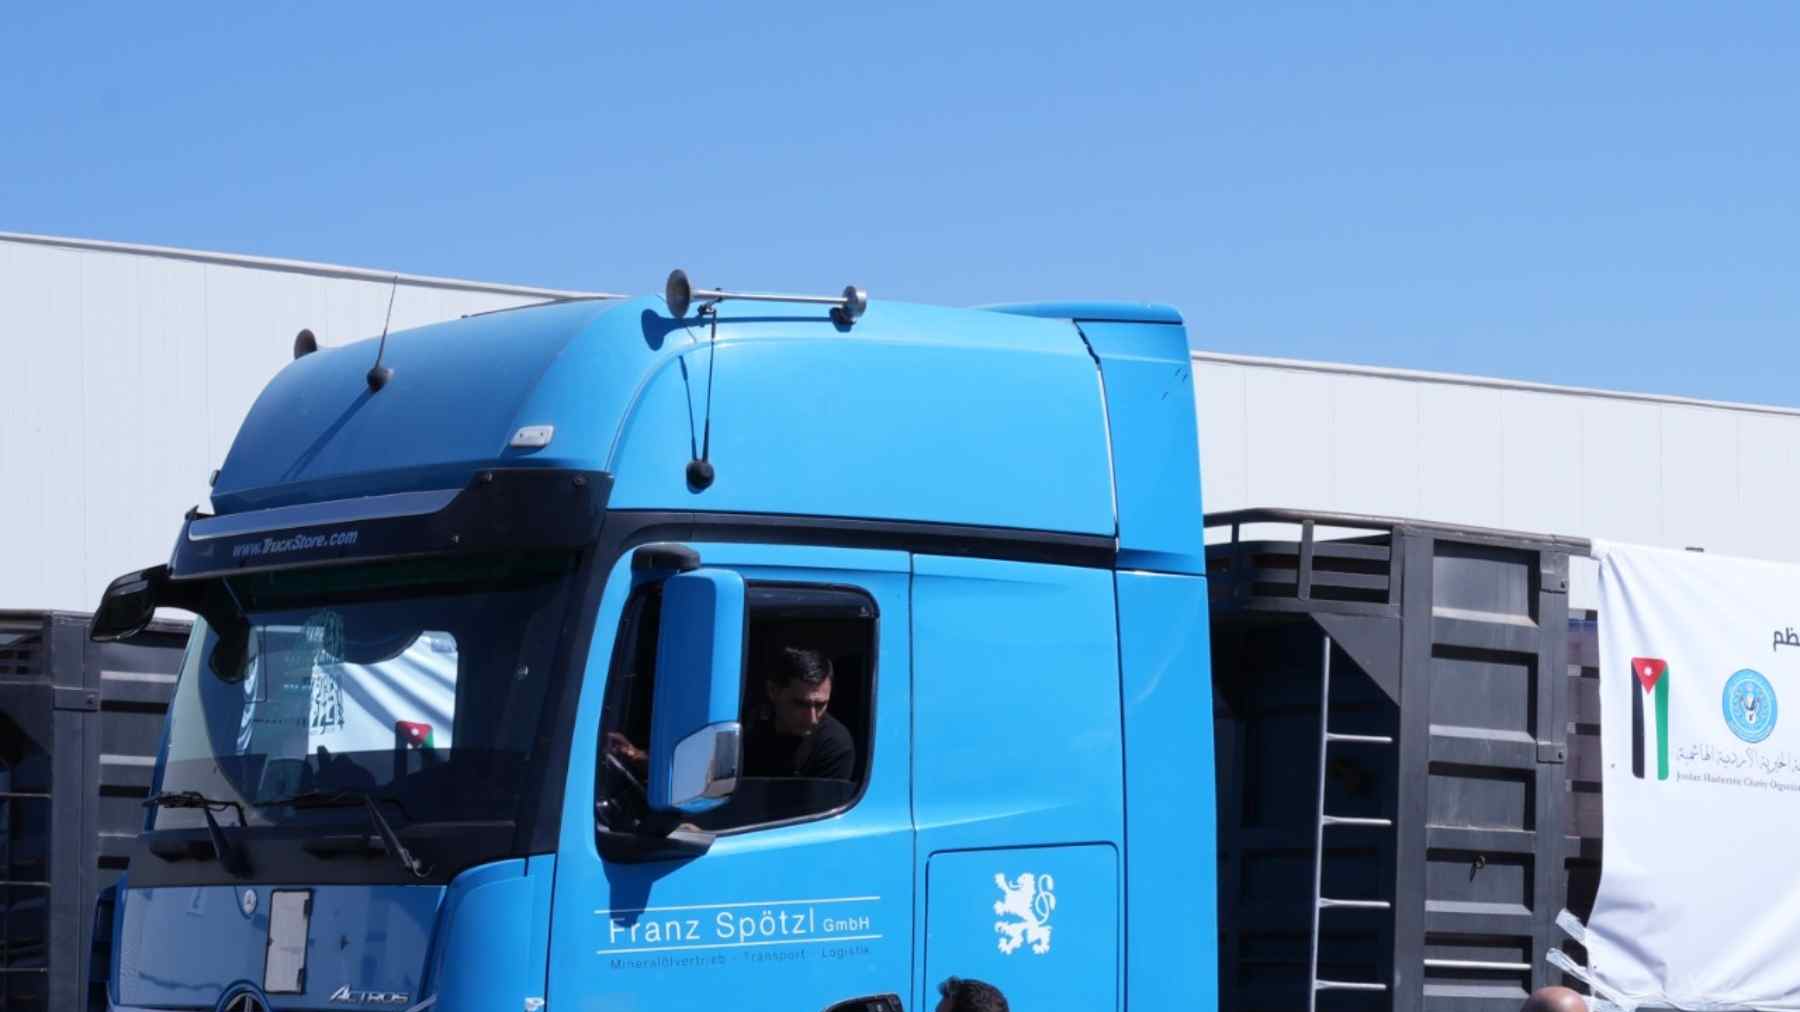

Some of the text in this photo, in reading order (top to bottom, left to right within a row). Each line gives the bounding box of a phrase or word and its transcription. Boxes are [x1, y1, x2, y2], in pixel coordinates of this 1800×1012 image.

[609, 906, 871, 945] Franz Spötzl GmbH
